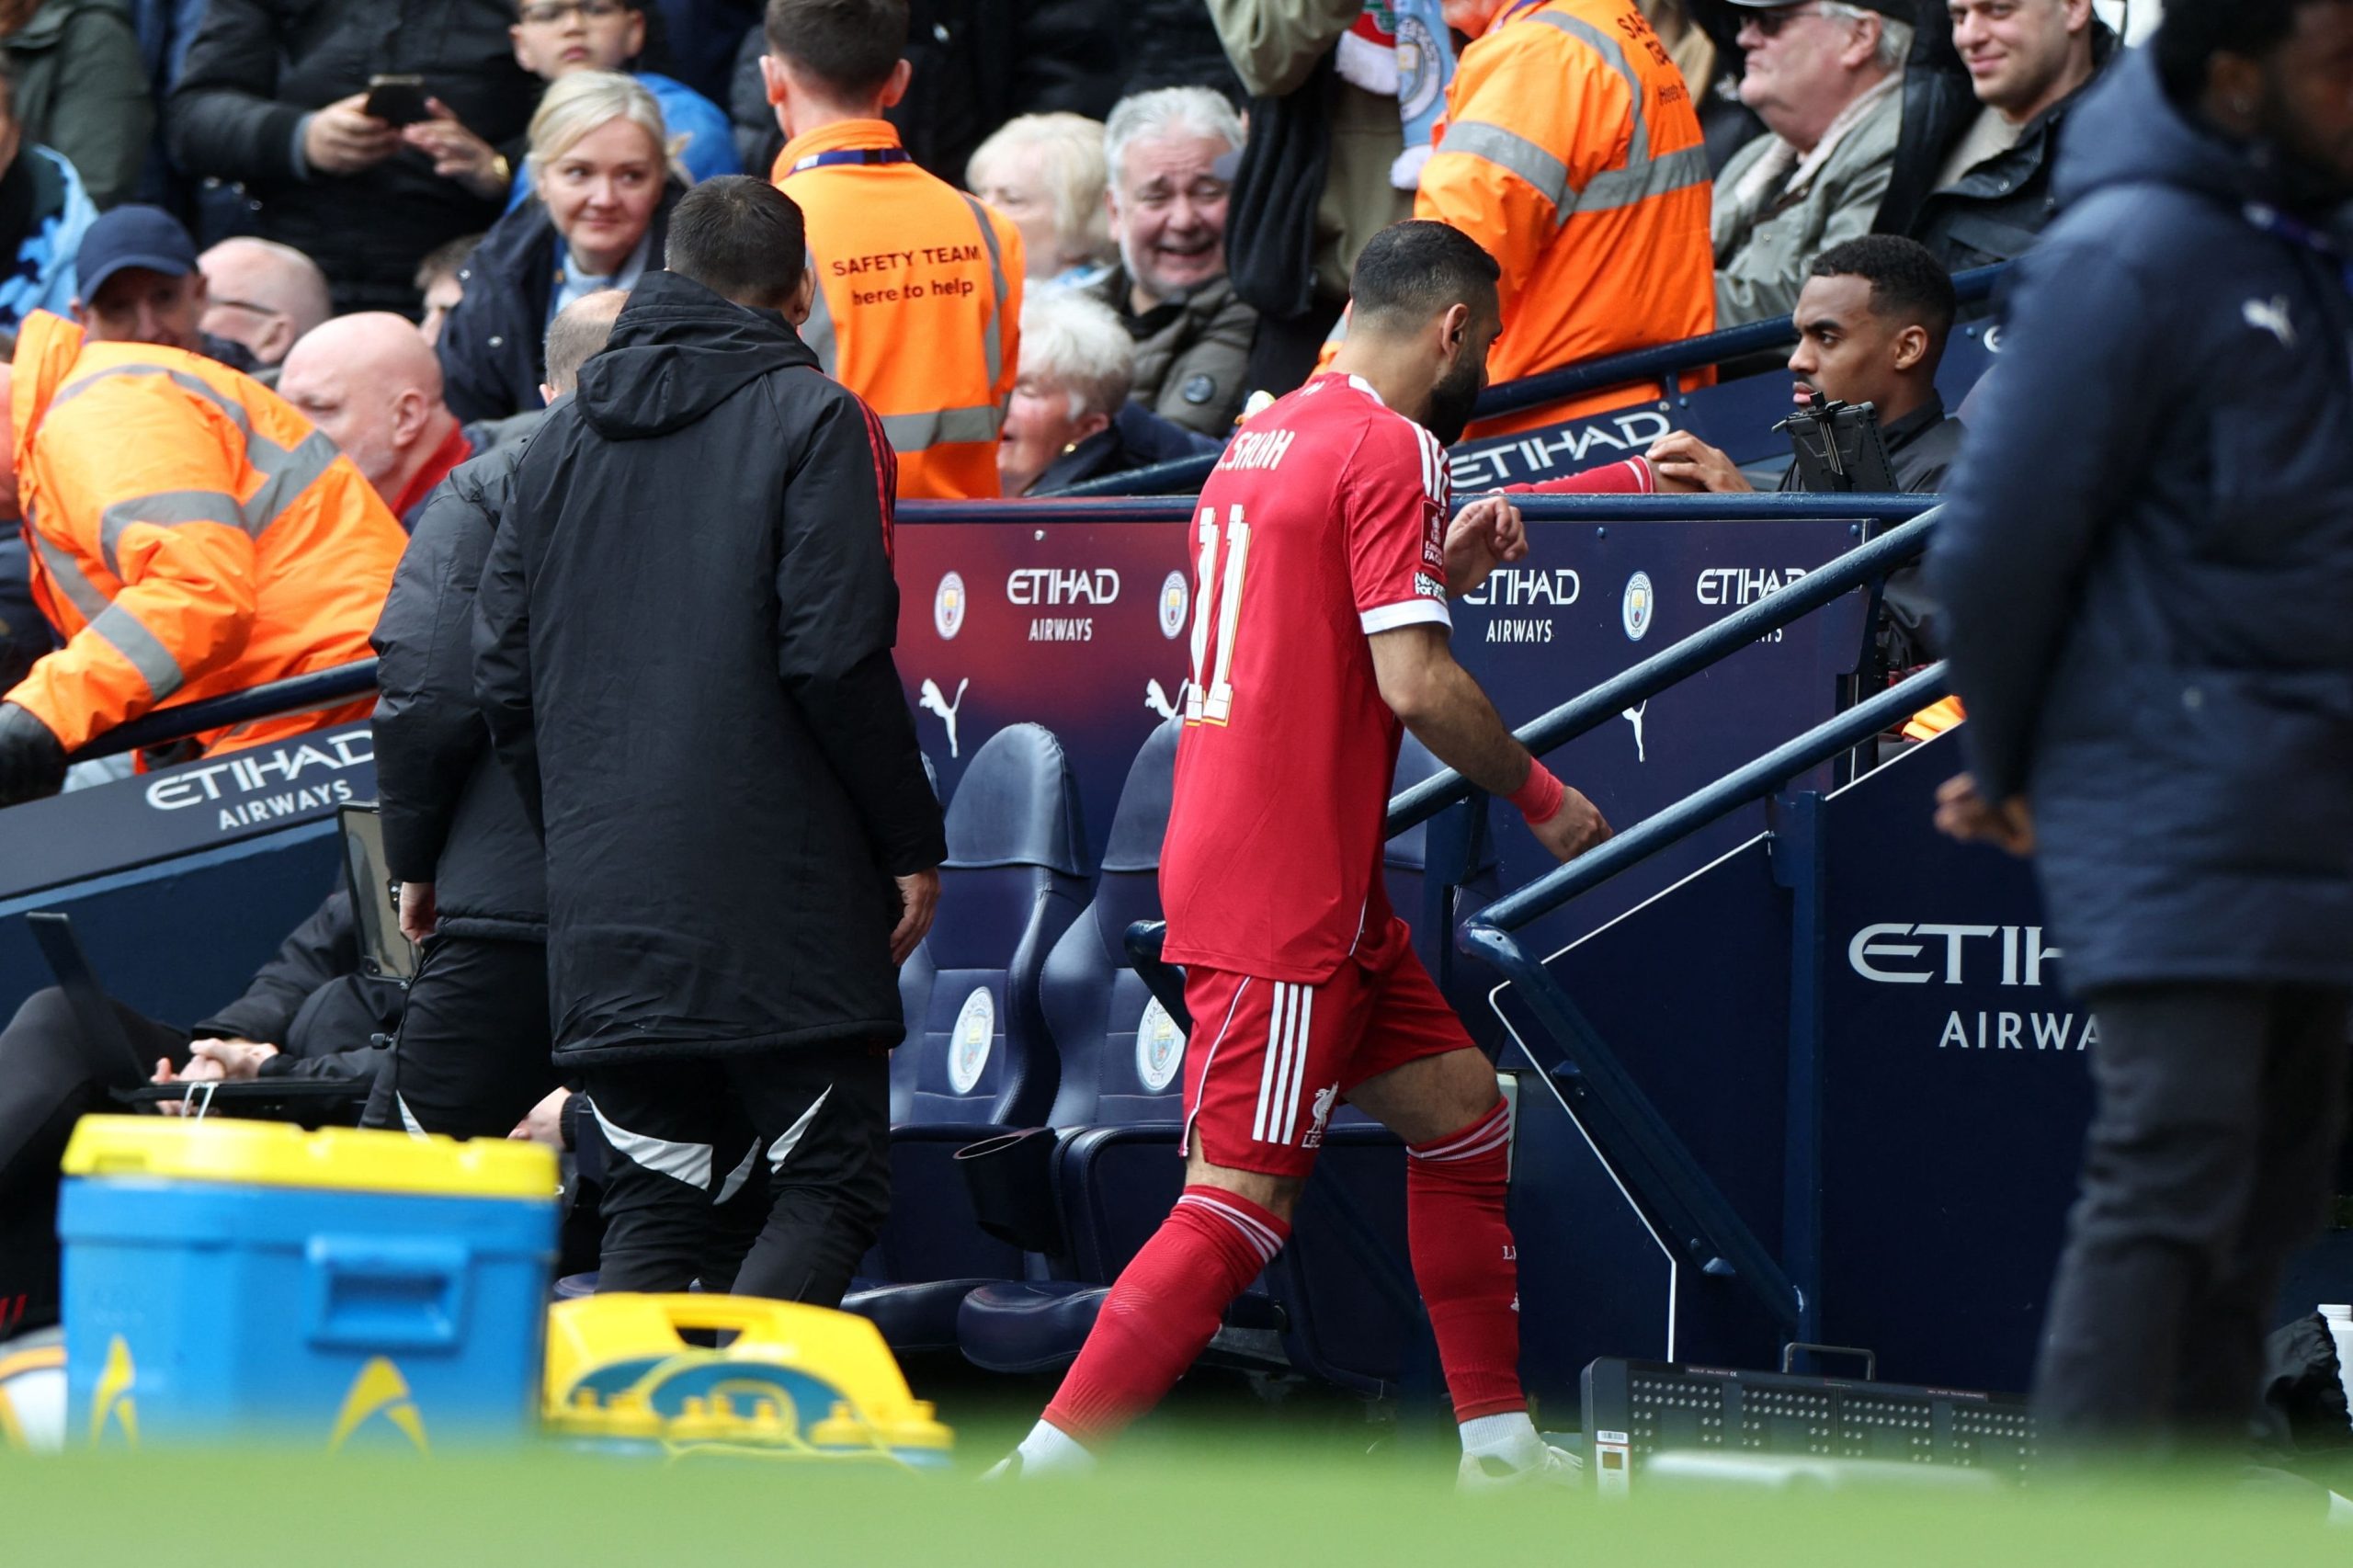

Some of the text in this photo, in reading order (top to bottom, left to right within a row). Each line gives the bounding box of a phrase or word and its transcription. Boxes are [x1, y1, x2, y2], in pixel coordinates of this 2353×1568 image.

[832, 244, 983, 277] SAFETY TEAM
[851, 278, 974, 306] here to help
[1449, 412, 1671, 488] ETIHAD
[1006, 569, 1120, 604] ETIHAD
[1028, 619, 1093, 642] AIRWAYS
[1186, 504, 1251, 727] 11
[1485, 619, 1552, 642] AIRWAYS
[145, 730, 375, 811] ETIHAD
[219, 779, 353, 831] AIRWAYS
